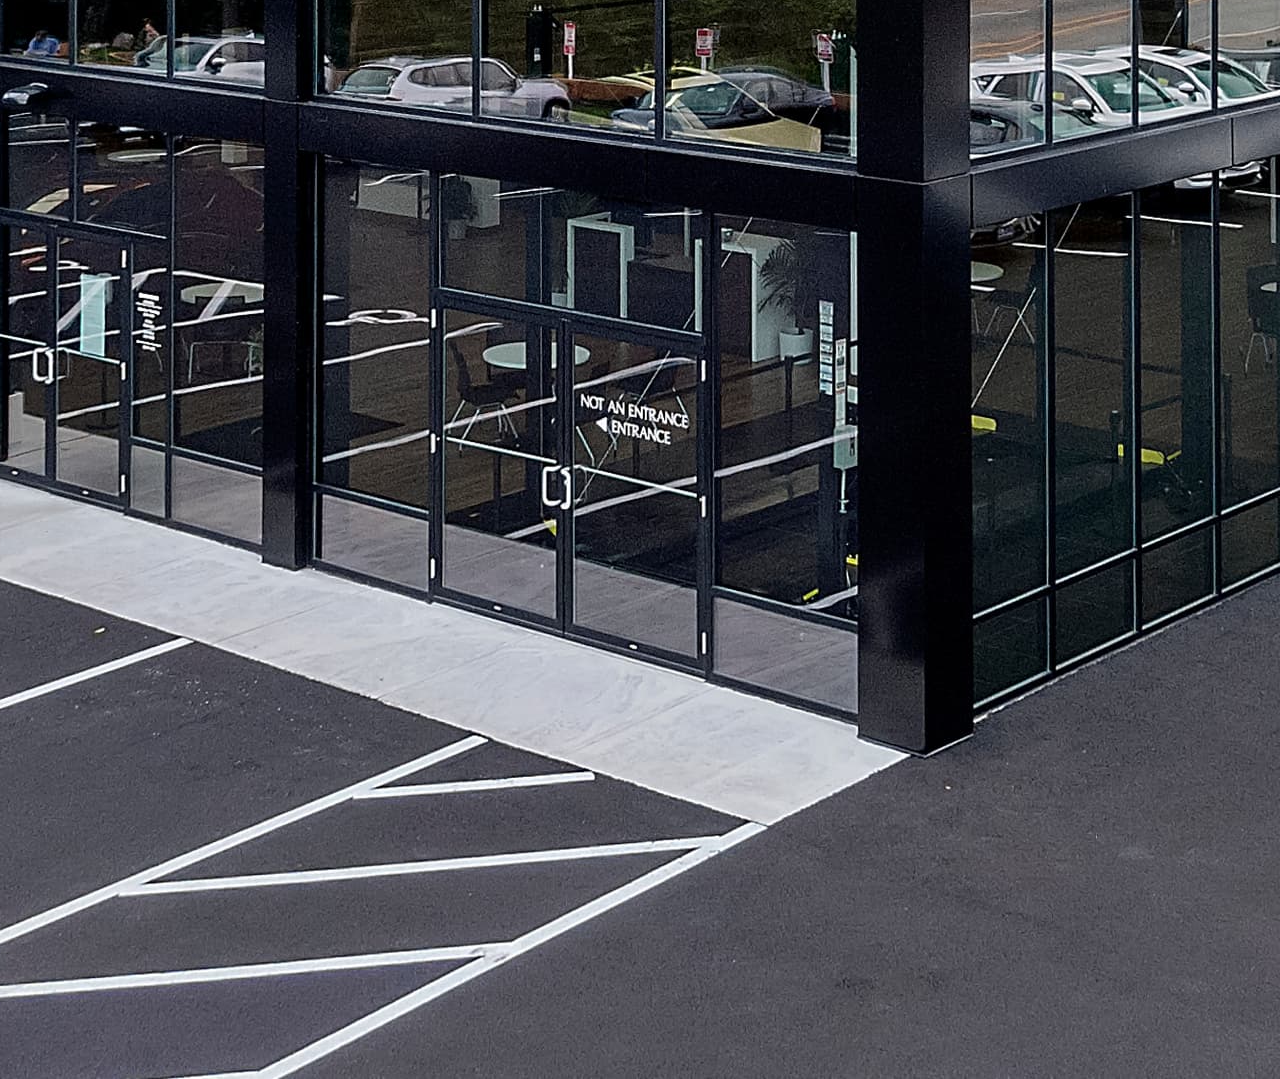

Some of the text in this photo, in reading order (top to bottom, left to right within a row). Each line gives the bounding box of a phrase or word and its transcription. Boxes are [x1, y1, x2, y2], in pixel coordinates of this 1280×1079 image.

[580, 393, 689, 429] NOT AN ENTRANCE
[611, 419, 671, 446] ENTRANCE
